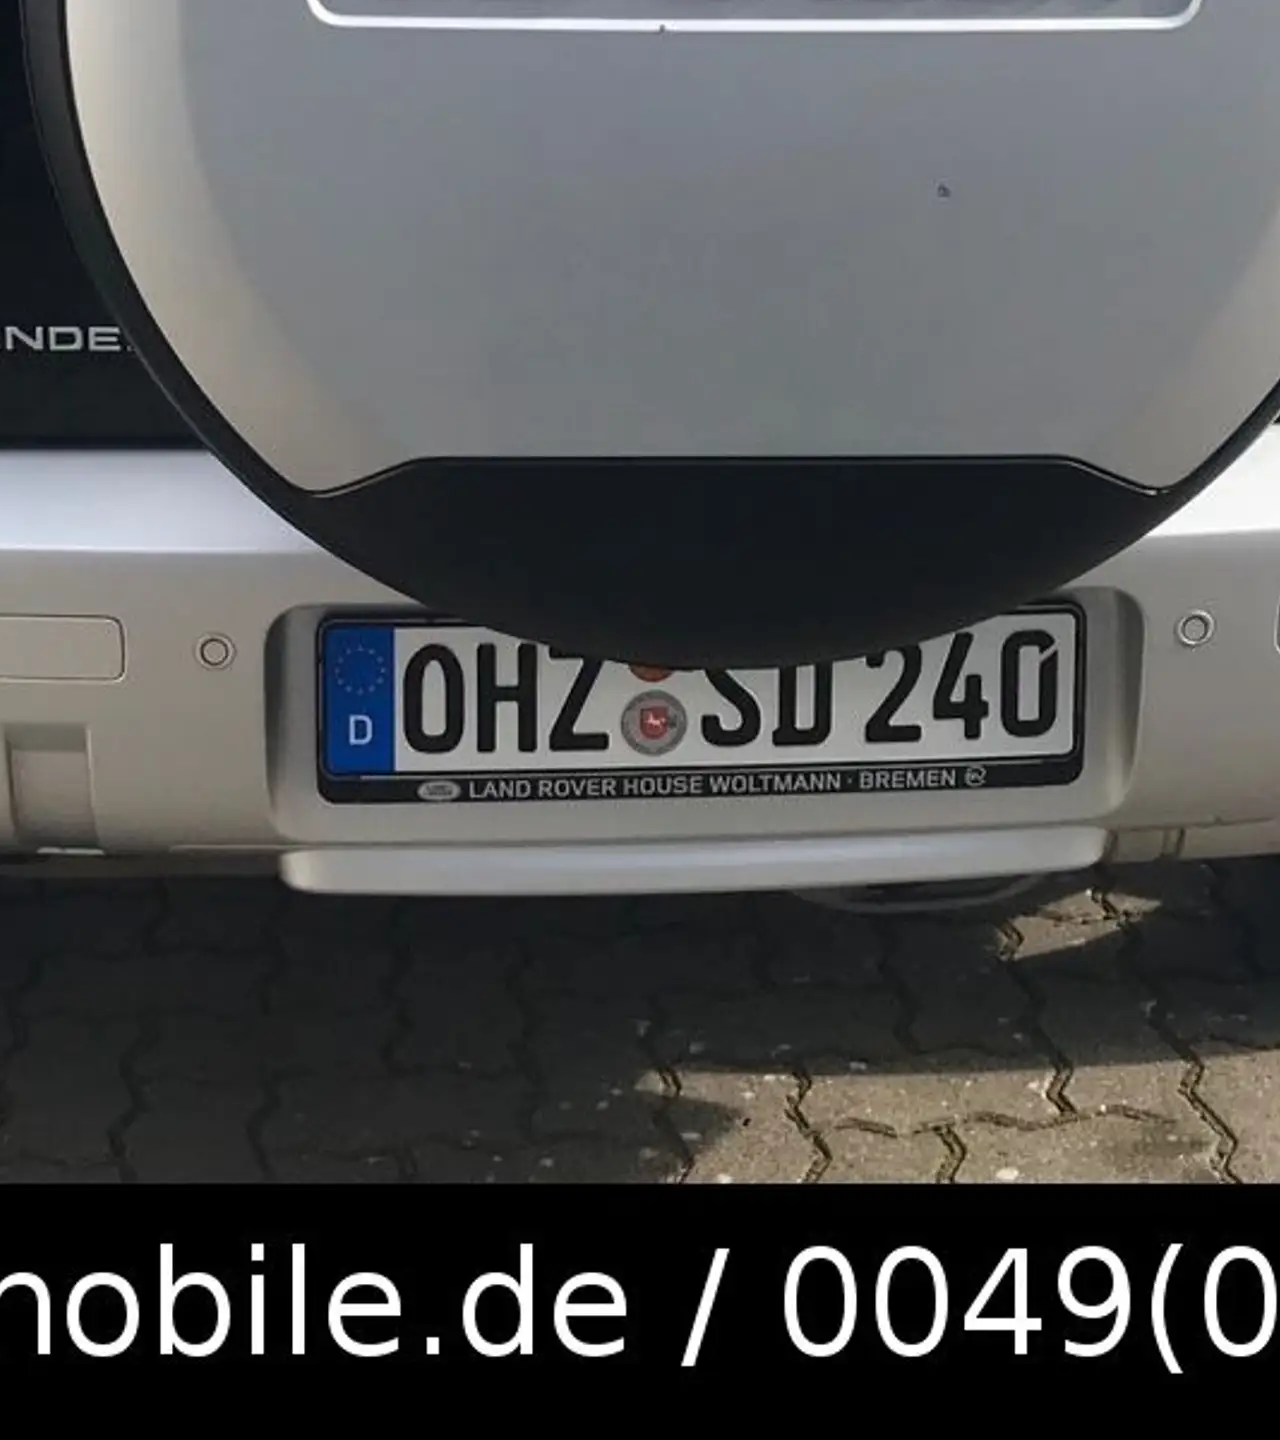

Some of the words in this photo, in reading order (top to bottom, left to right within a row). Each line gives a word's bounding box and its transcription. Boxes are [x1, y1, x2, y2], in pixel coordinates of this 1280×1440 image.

[402, 641, 609, 754] OHZ
[700, 663, 831, 748] SD
[865, 629, 1058, 743] 240
[349, 714, 373, 745] D
[468, 779, 532, 798] LAND
[537, 777, 617, 797] ROVER
[622, 775, 704, 796] HOUSE
[709, 771, 842, 794] WOLTMANN
[859, 768, 957, 789] BREMEN
